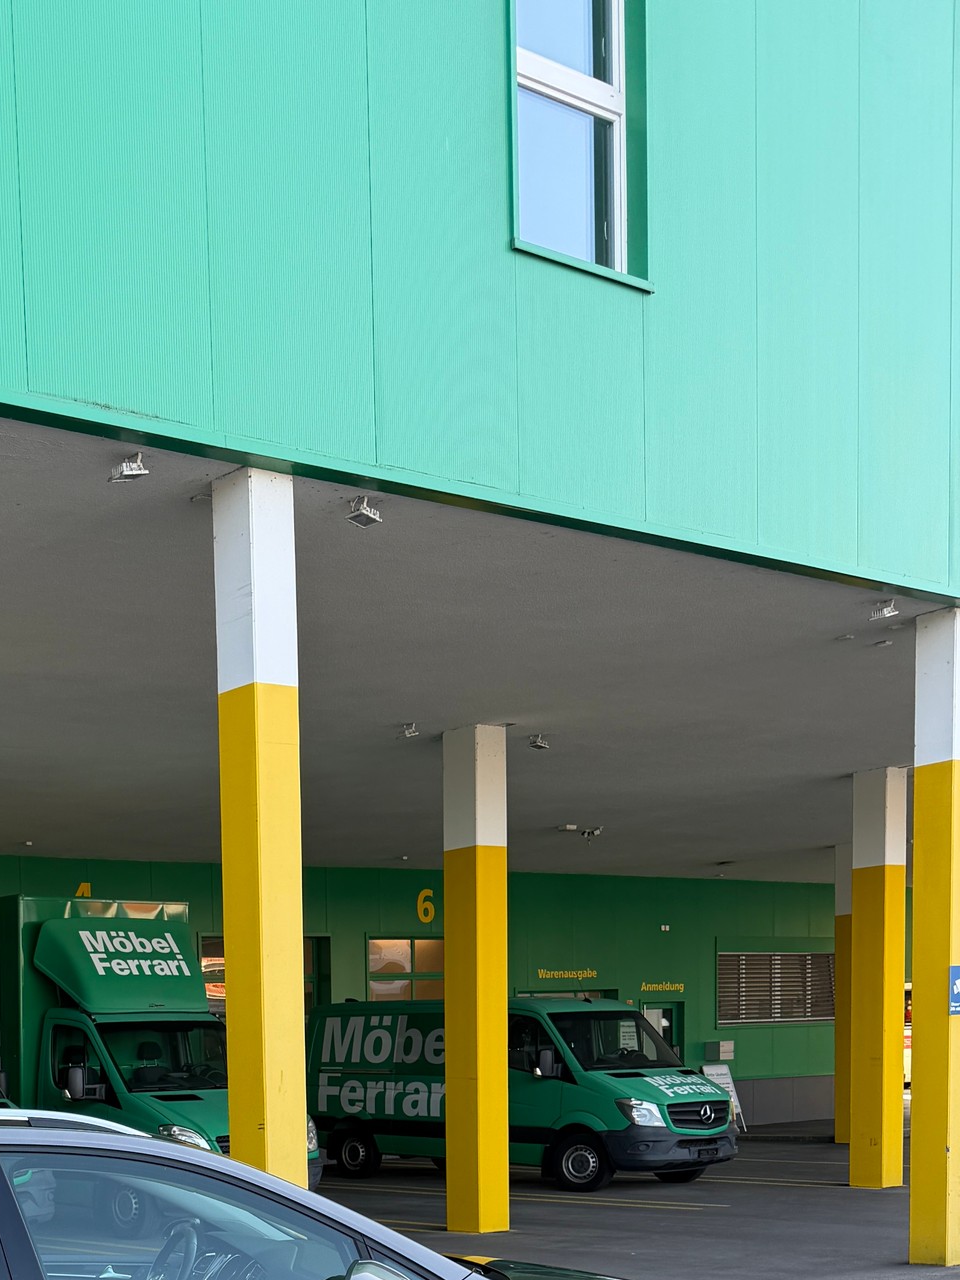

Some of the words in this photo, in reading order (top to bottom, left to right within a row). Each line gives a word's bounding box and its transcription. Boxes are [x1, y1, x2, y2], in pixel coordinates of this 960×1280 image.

[417, 888, 435, 924] 6
[78, 930, 181, 955] Möbel
[89, 953, 192, 977] Ferrari
[538, 968, 597, 980] Warenausgabe
[641, 981, 685, 993] Anmeldung
[321, 1015, 445, 1065] Möbe
[318, 1066, 446, 1118] Ferrar
[643, 1075, 706, 1088] Möbel
[658, 1084, 722, 1098] Ferrari
